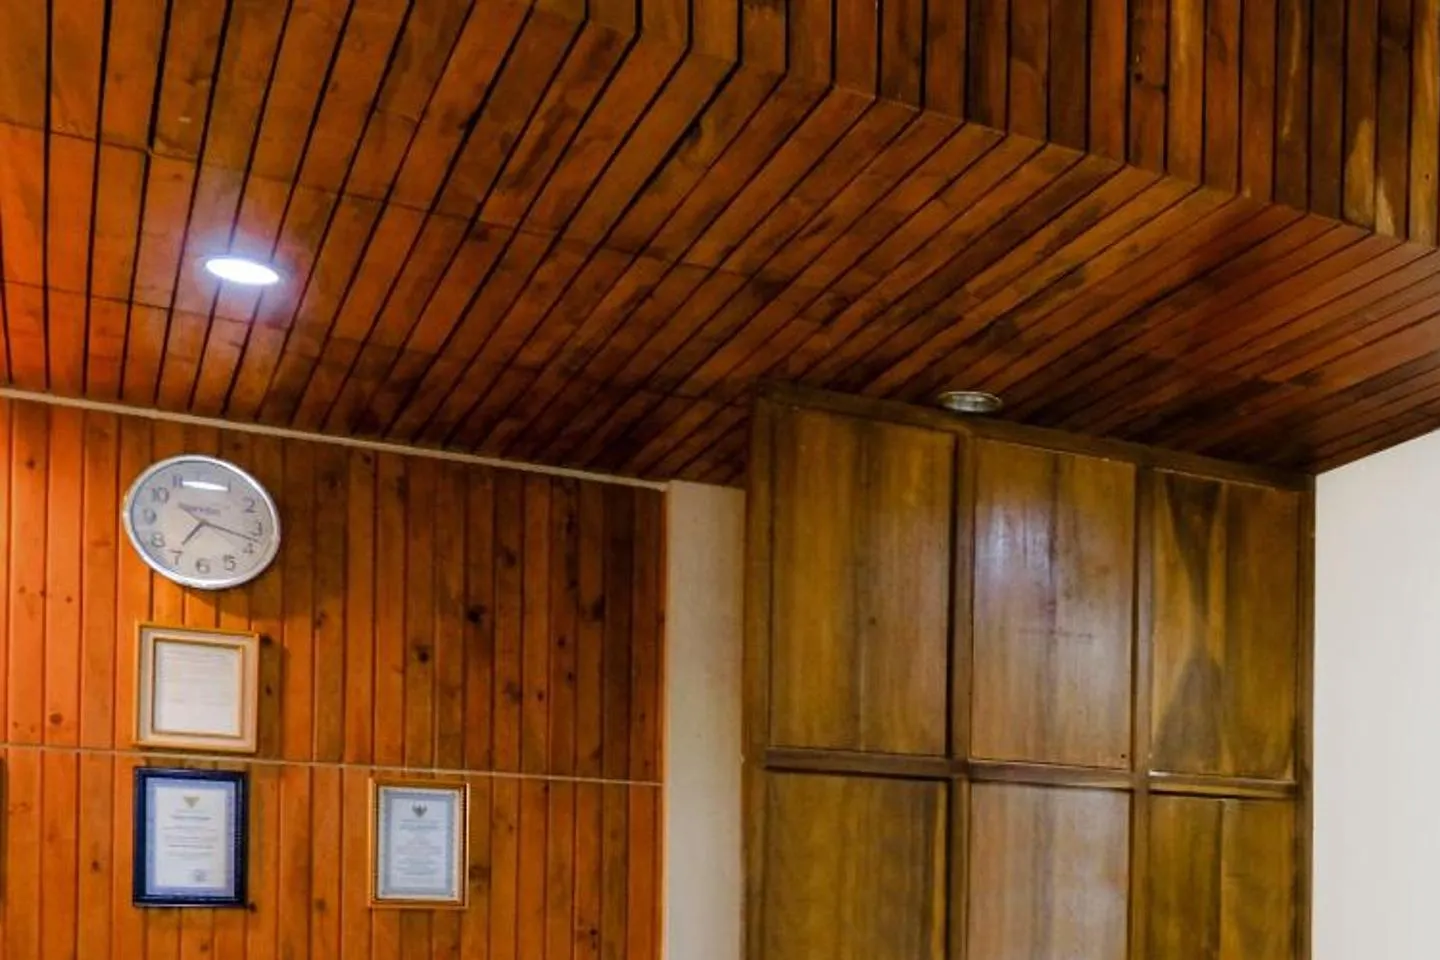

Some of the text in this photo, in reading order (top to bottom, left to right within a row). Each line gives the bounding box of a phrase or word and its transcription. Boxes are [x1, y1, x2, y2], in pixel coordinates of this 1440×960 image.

[153, 486, 170, 504] 10
[241, 496, 256, 514] 2
[143, 507, 157, 525] 9
[151, 531, 166, 548] 8
[169, 549, 183, 566] 7
[195, 557, 211, 574] 6
[223, 554, 237, 571] 5
